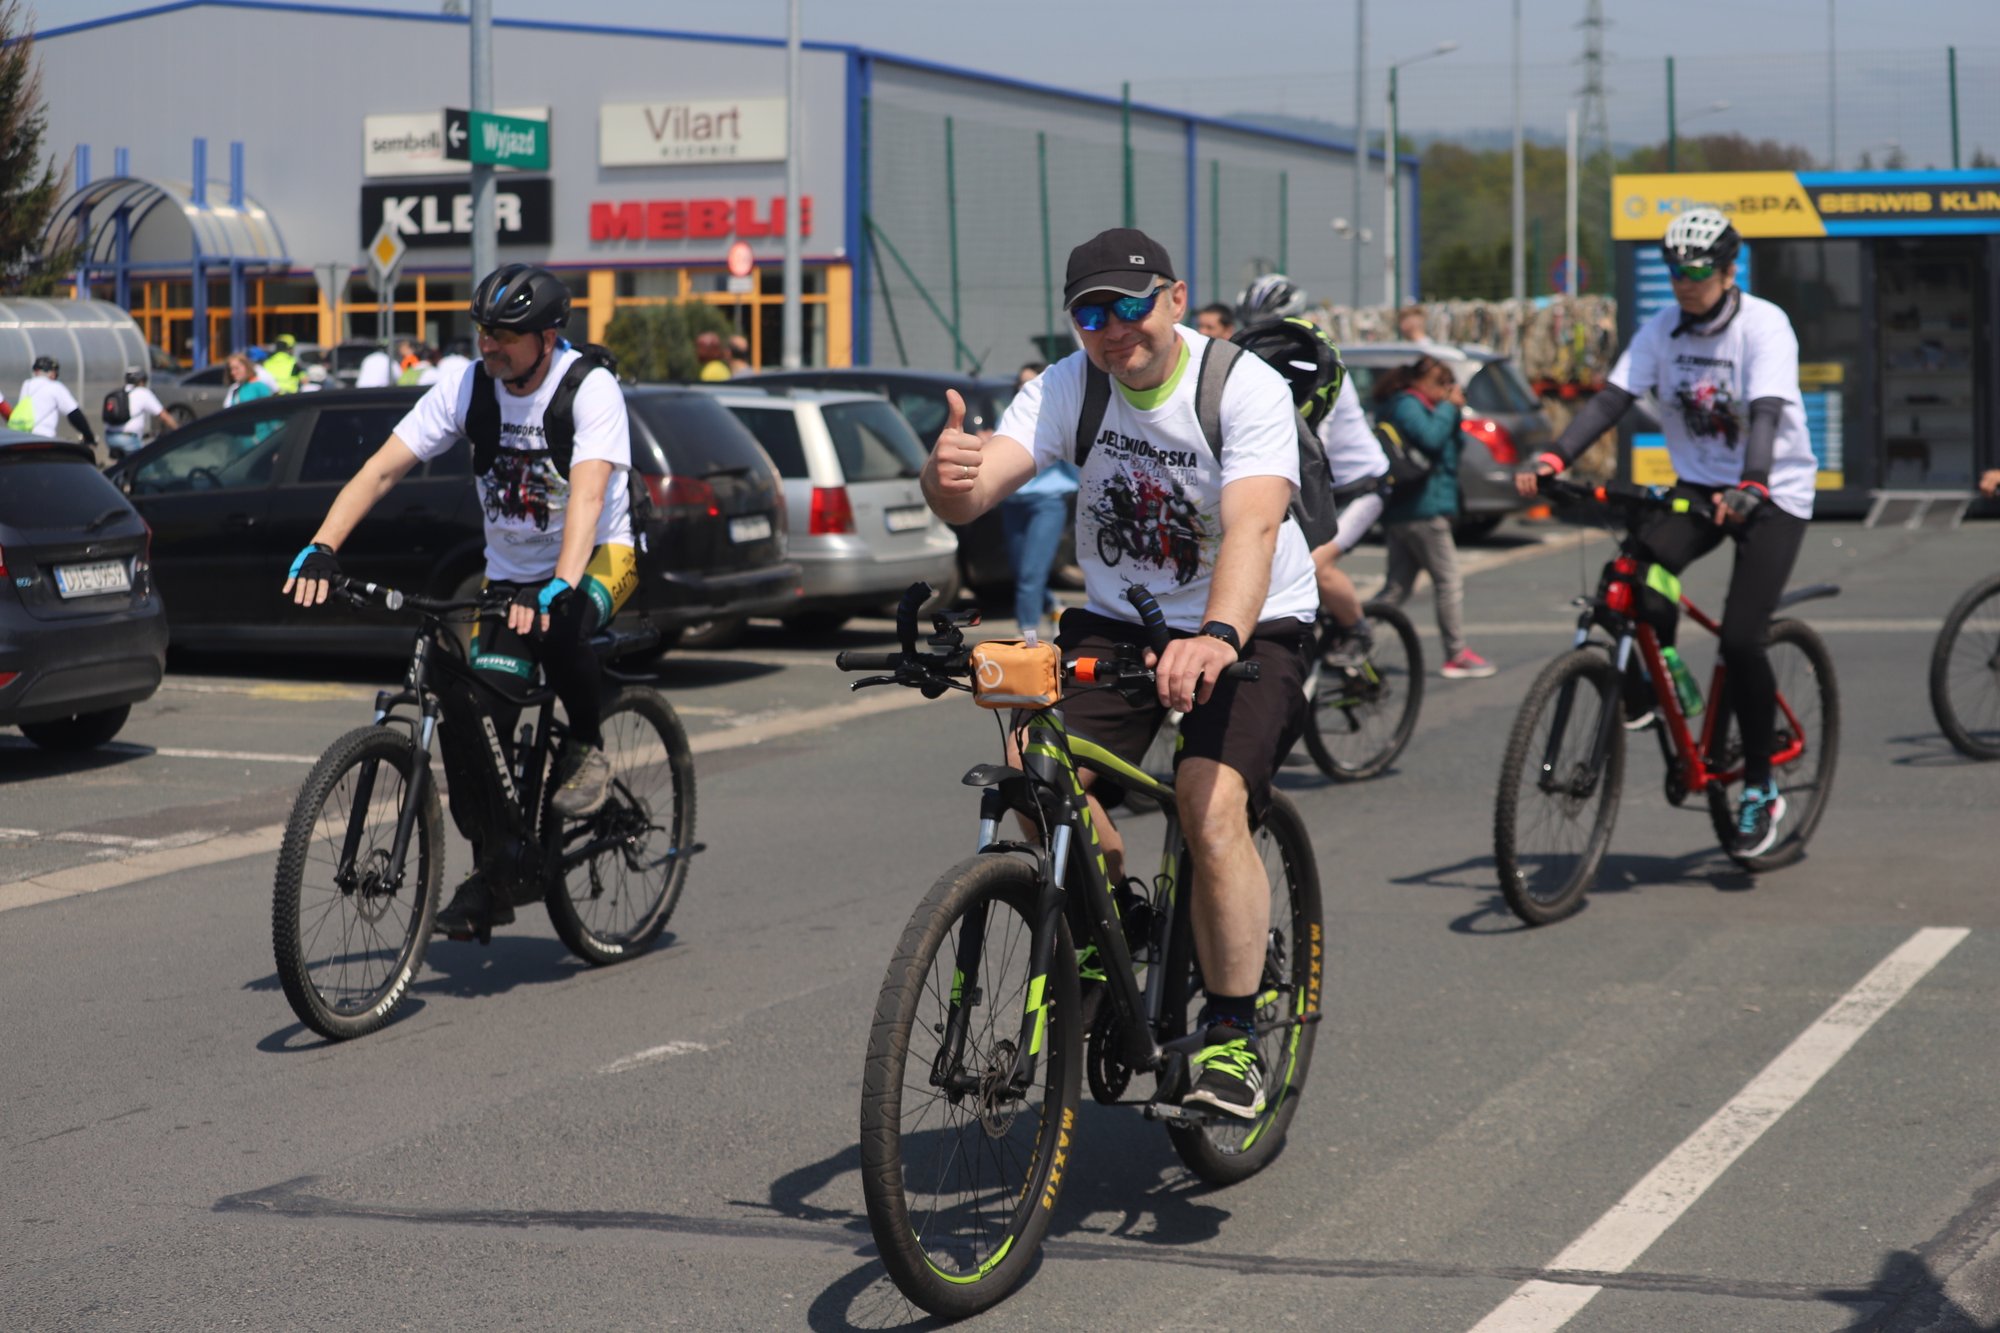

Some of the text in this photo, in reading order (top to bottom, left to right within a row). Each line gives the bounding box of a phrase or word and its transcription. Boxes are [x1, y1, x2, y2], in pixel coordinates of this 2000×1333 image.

[372, 131, 442, 152] sembell
[481, 121, 536, 159] Wyjazd
[644, 106, 740, 142] Vilart
[382, 194, 522, 235] KLER
[590, 195, 813, 240] MEBLE
[1305, 923, 1320, 1012] MAXXIS
[1042, 1107, 1074, 1210] MAXXIS
